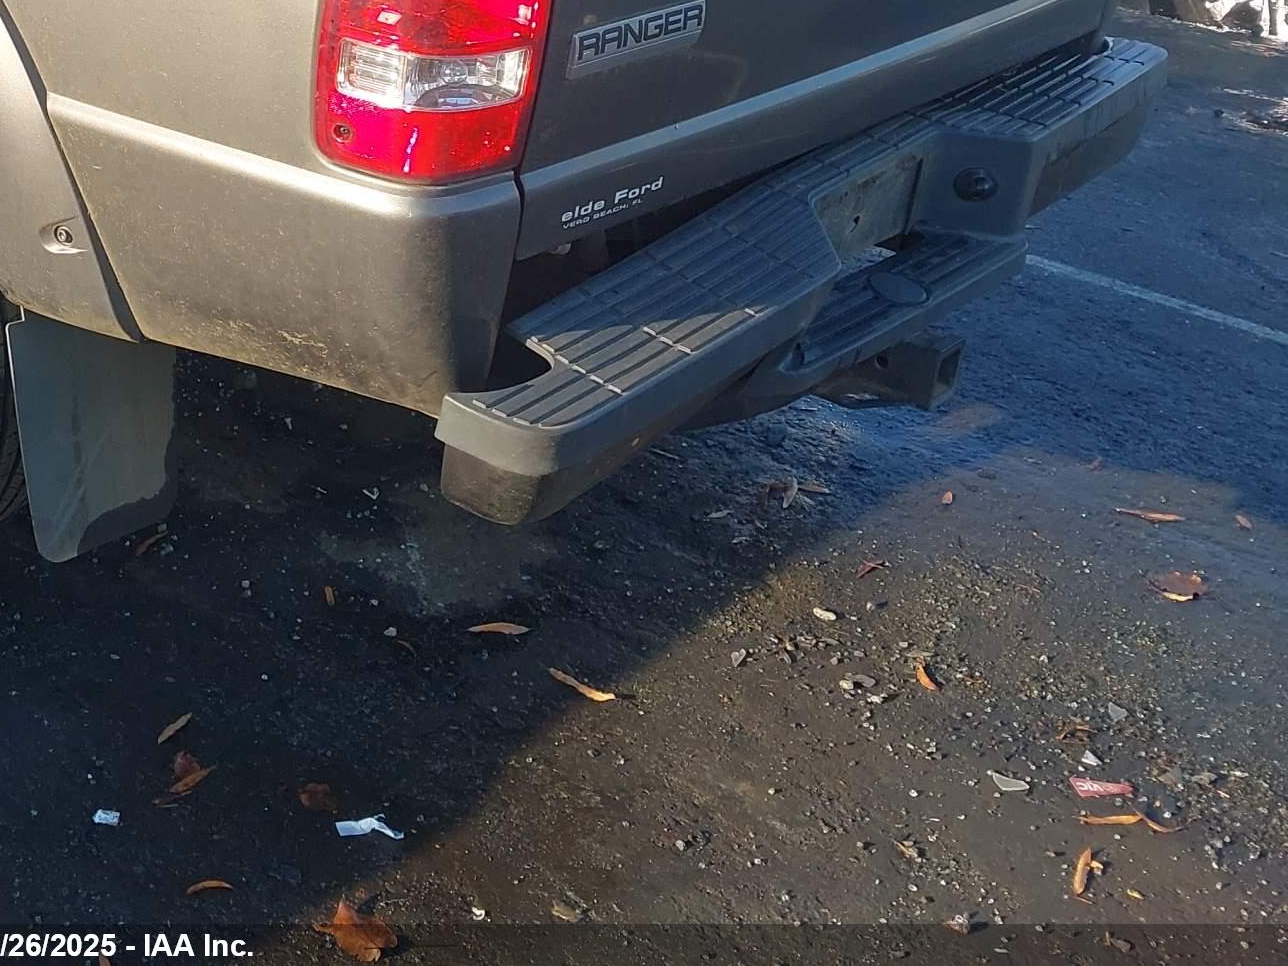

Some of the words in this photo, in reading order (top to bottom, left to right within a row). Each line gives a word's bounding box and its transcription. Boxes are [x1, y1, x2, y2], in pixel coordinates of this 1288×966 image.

[577, 4, 704, 61] RANGER
[561, 200, 605, 222] elde
[614, 176, 664, 204] Ford
[563, 216, 590, 229] VERO
